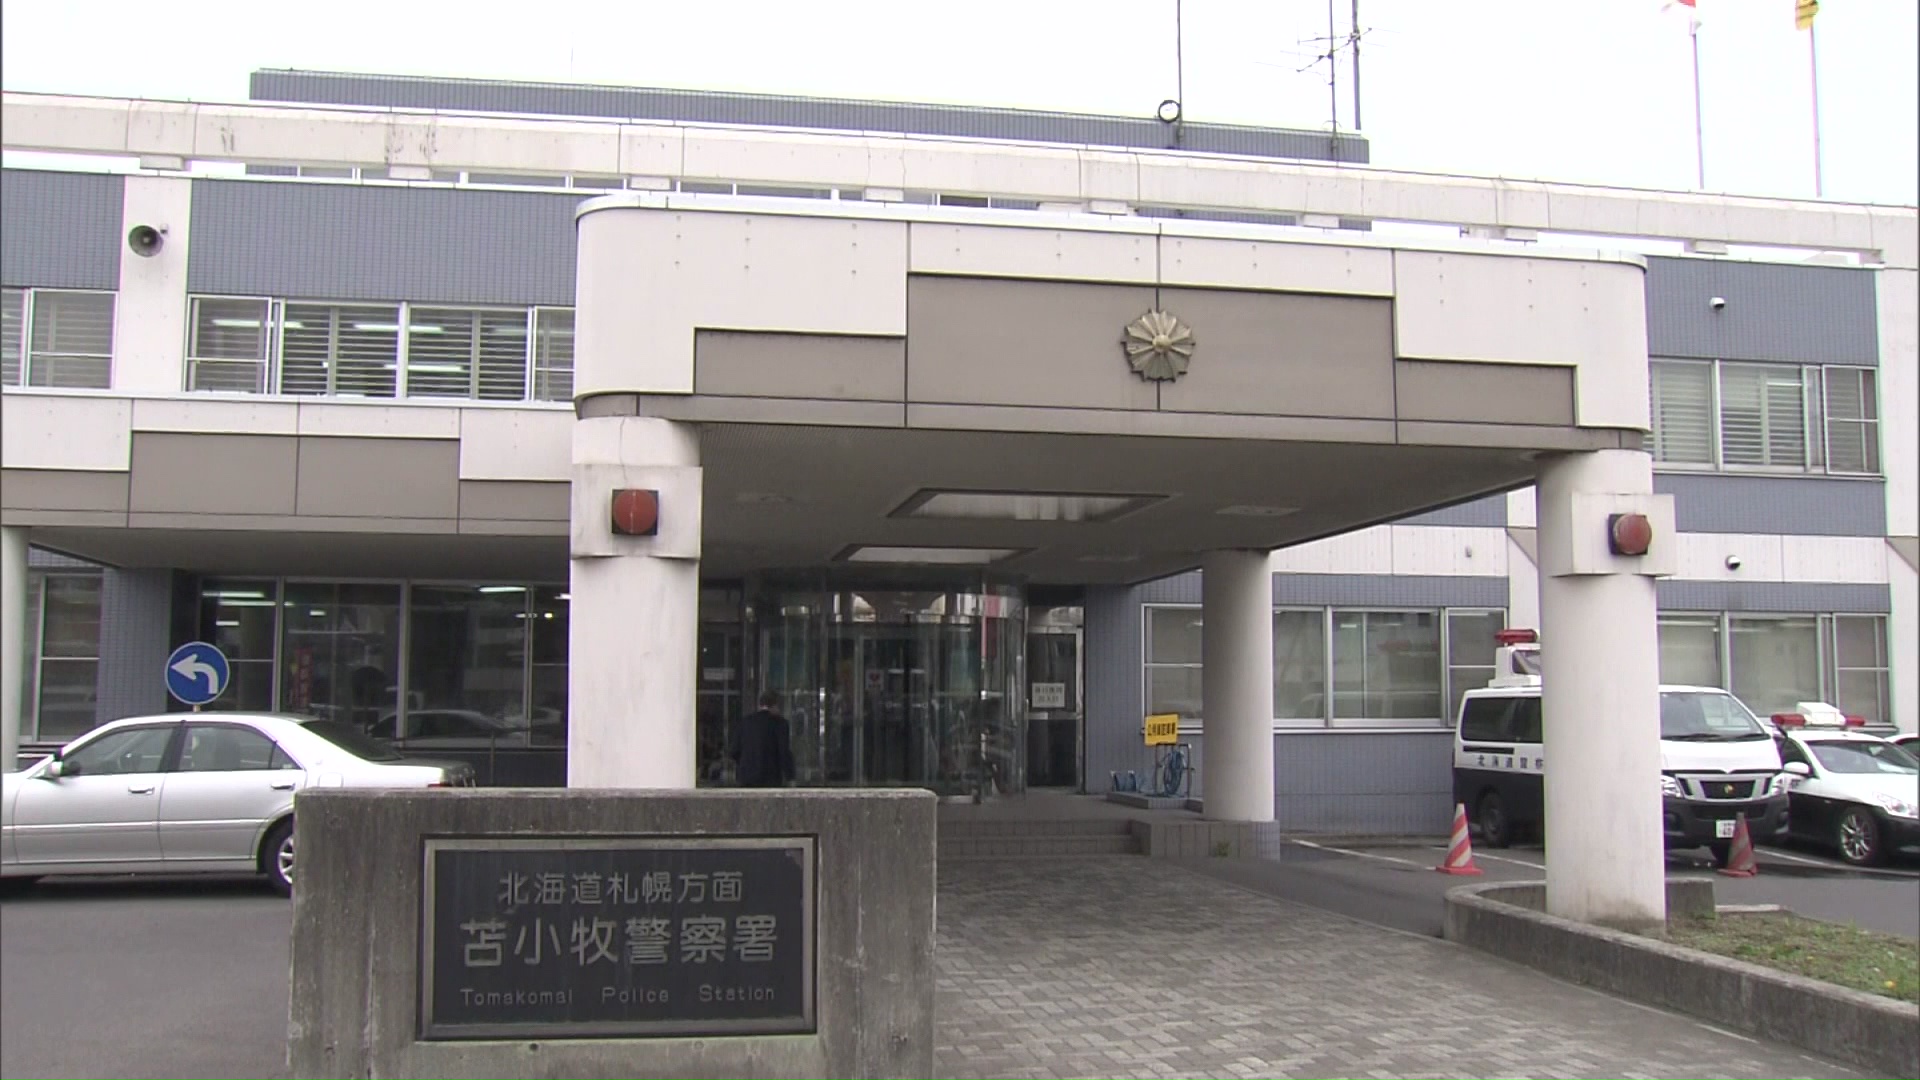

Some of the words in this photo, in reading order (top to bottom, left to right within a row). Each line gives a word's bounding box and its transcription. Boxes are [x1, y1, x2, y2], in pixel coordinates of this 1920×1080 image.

[497, 870, 744, 906] 北海道札幌方面
[459, 914, 778, 968] 苫小牧警察署
[460, 987, 573, 1007] Tomakomai
[601, 986, 670, 1004] Police
[698, 985, 775, 1003] Station
